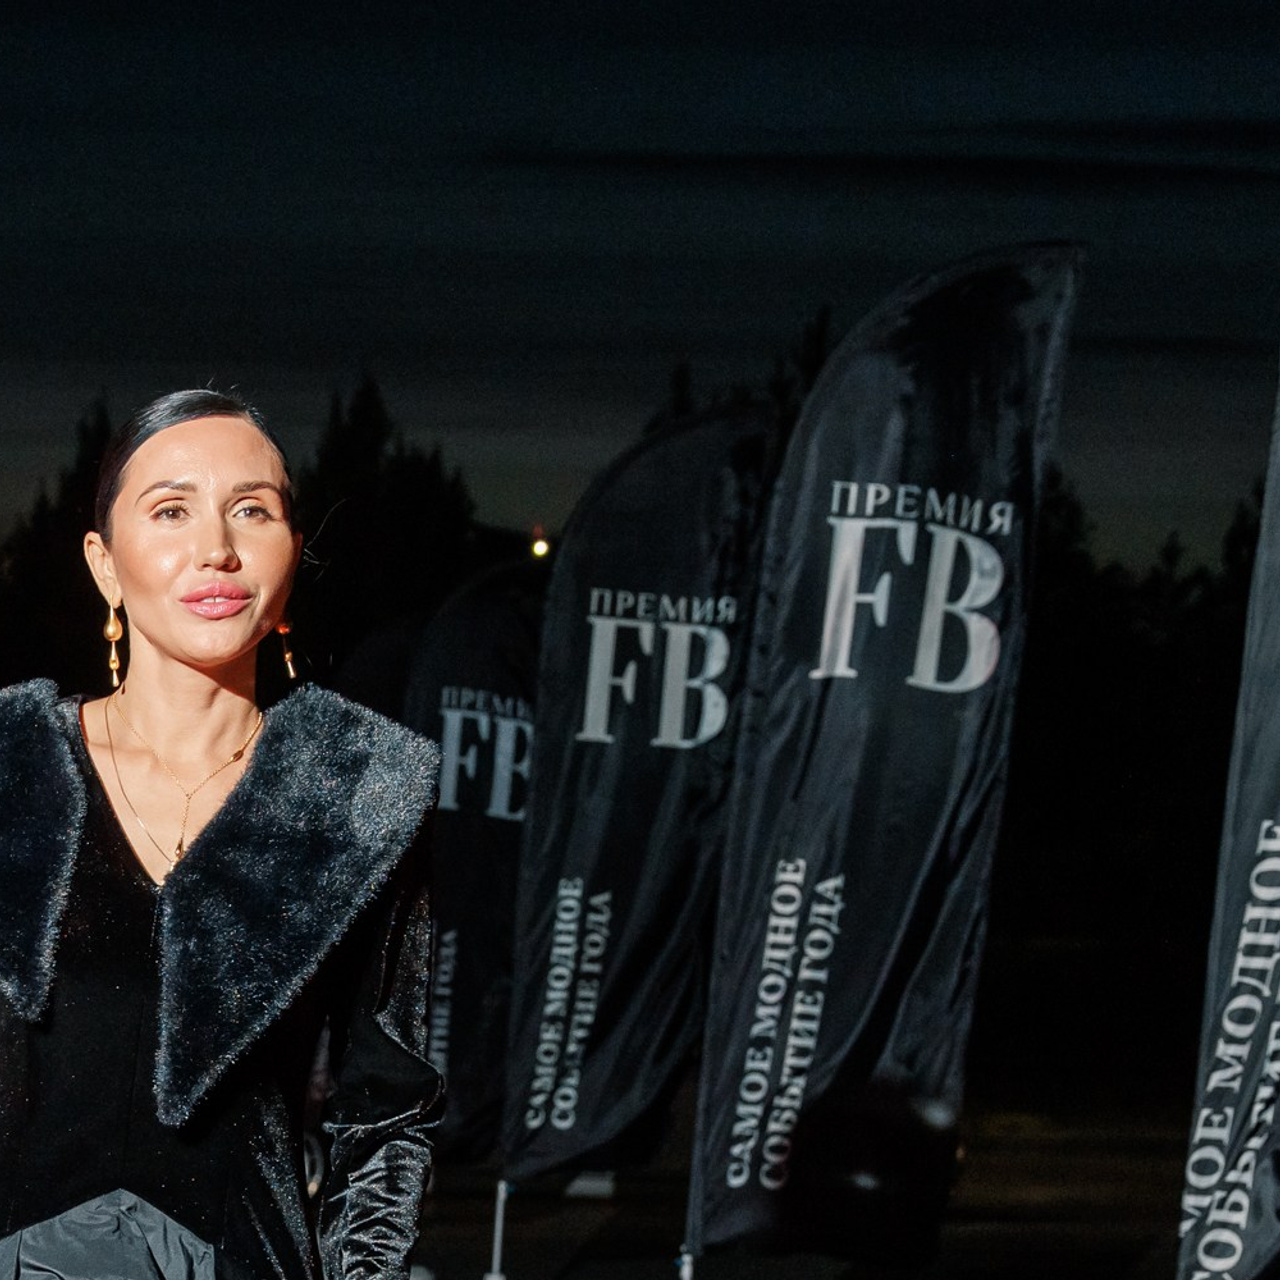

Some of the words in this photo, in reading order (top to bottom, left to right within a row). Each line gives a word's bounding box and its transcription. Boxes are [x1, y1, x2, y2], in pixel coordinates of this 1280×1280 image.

[831, 479, 1015, 537] ПРЕМИЯ
[590, 587, 737, 623] ПРЕМИЯ
[809, 515, 1005, 694] FB
[575, 614, 731, 749] FB
[542, 877, 584, 1018] МОДНОЕ
[579, 889, 613, 975] ГОДА
[524, 1021, 565, 1130] САМОЕ
[726, 1046, 771, 1189] САМОЕ
[749, 857, 807, 1038] МОДНОЕ
[758, 990, 825, 1190] СОБЫТИЕ
[797, 873, 846, 984] ГОДА
[1178, 1107, 1234, 1239] МОЕ
